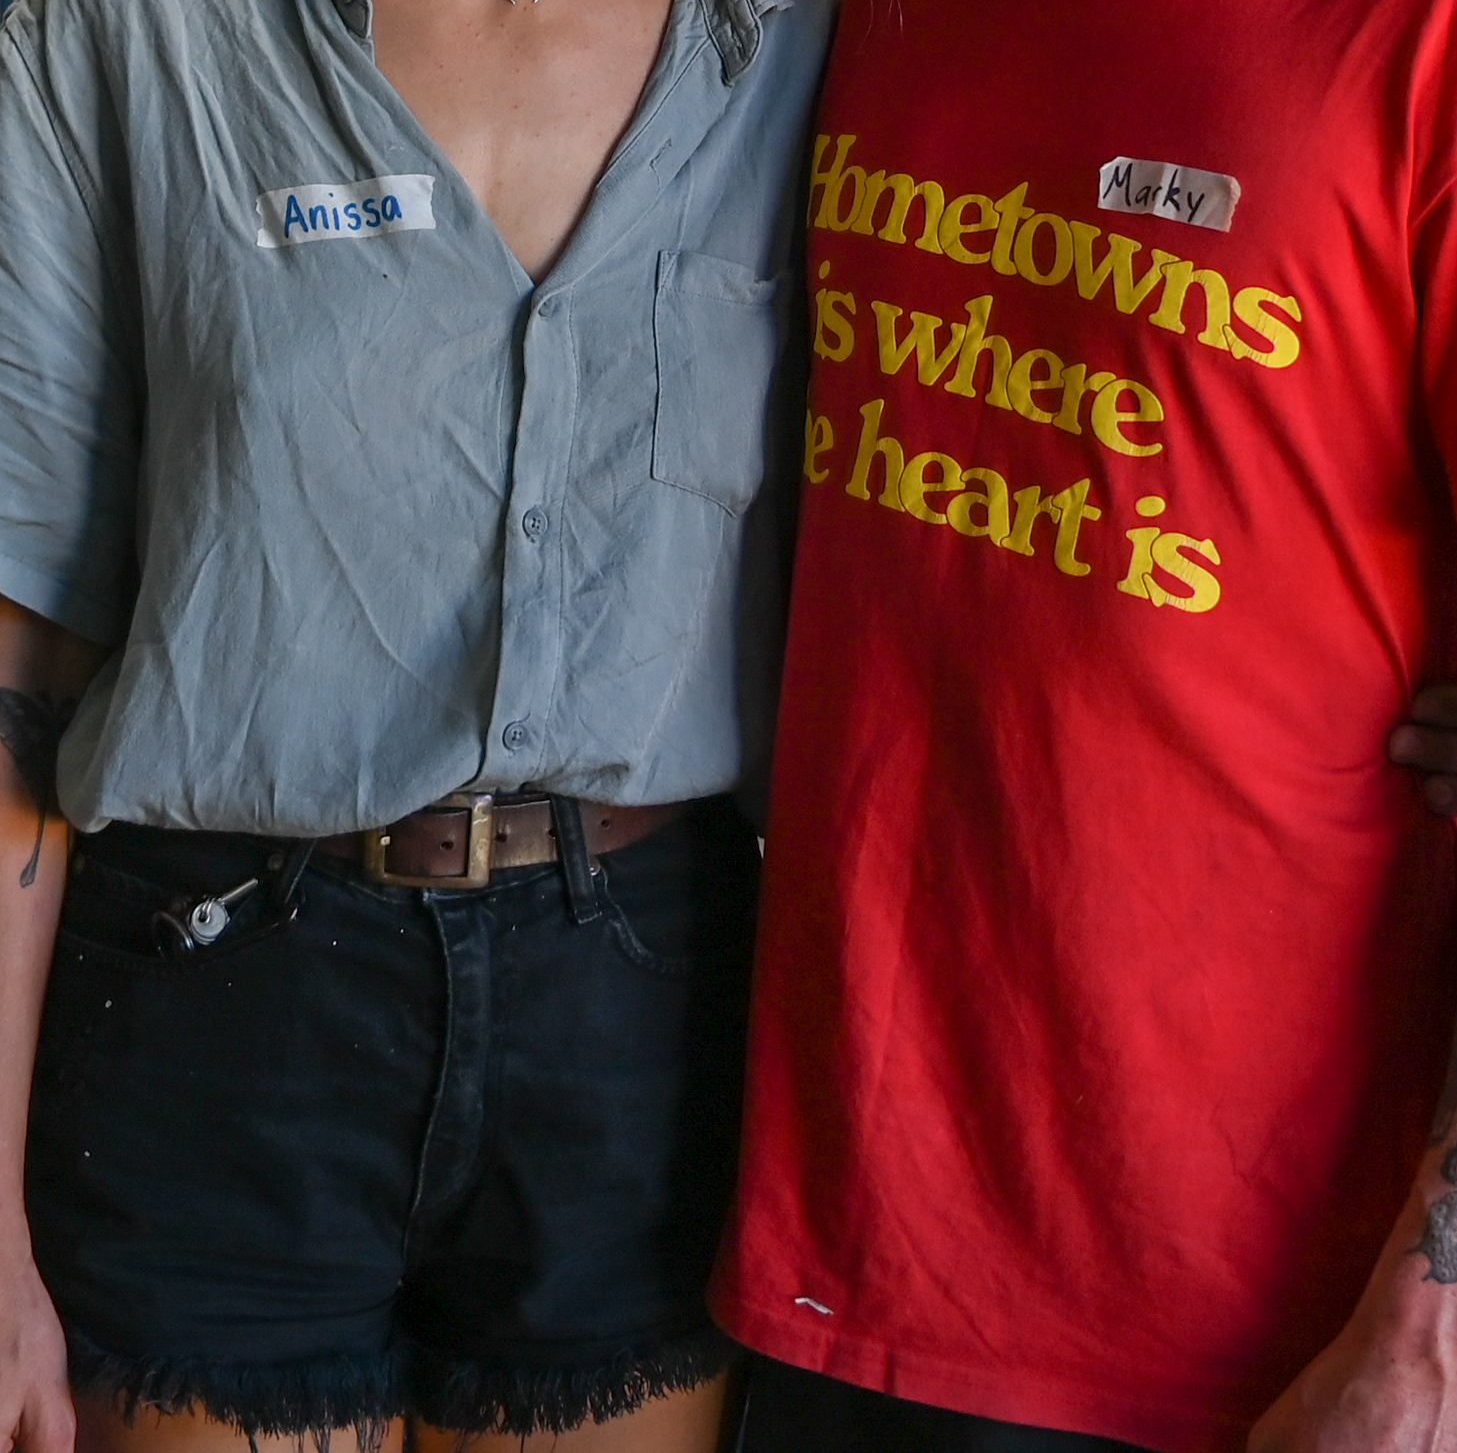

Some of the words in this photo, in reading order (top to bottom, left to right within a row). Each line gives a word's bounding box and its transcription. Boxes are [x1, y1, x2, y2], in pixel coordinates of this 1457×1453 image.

[283, 192, 403, 238] Anissa
[808, 132, 1304, 369] Hometowns
[1102, 163, 1206, 223] Marky
[814, 262, 856, 364] is
[873, 294, 1165, 458] where
[845, 396, 1102, 577] heart
[1117, 496, 1223, 613] is
